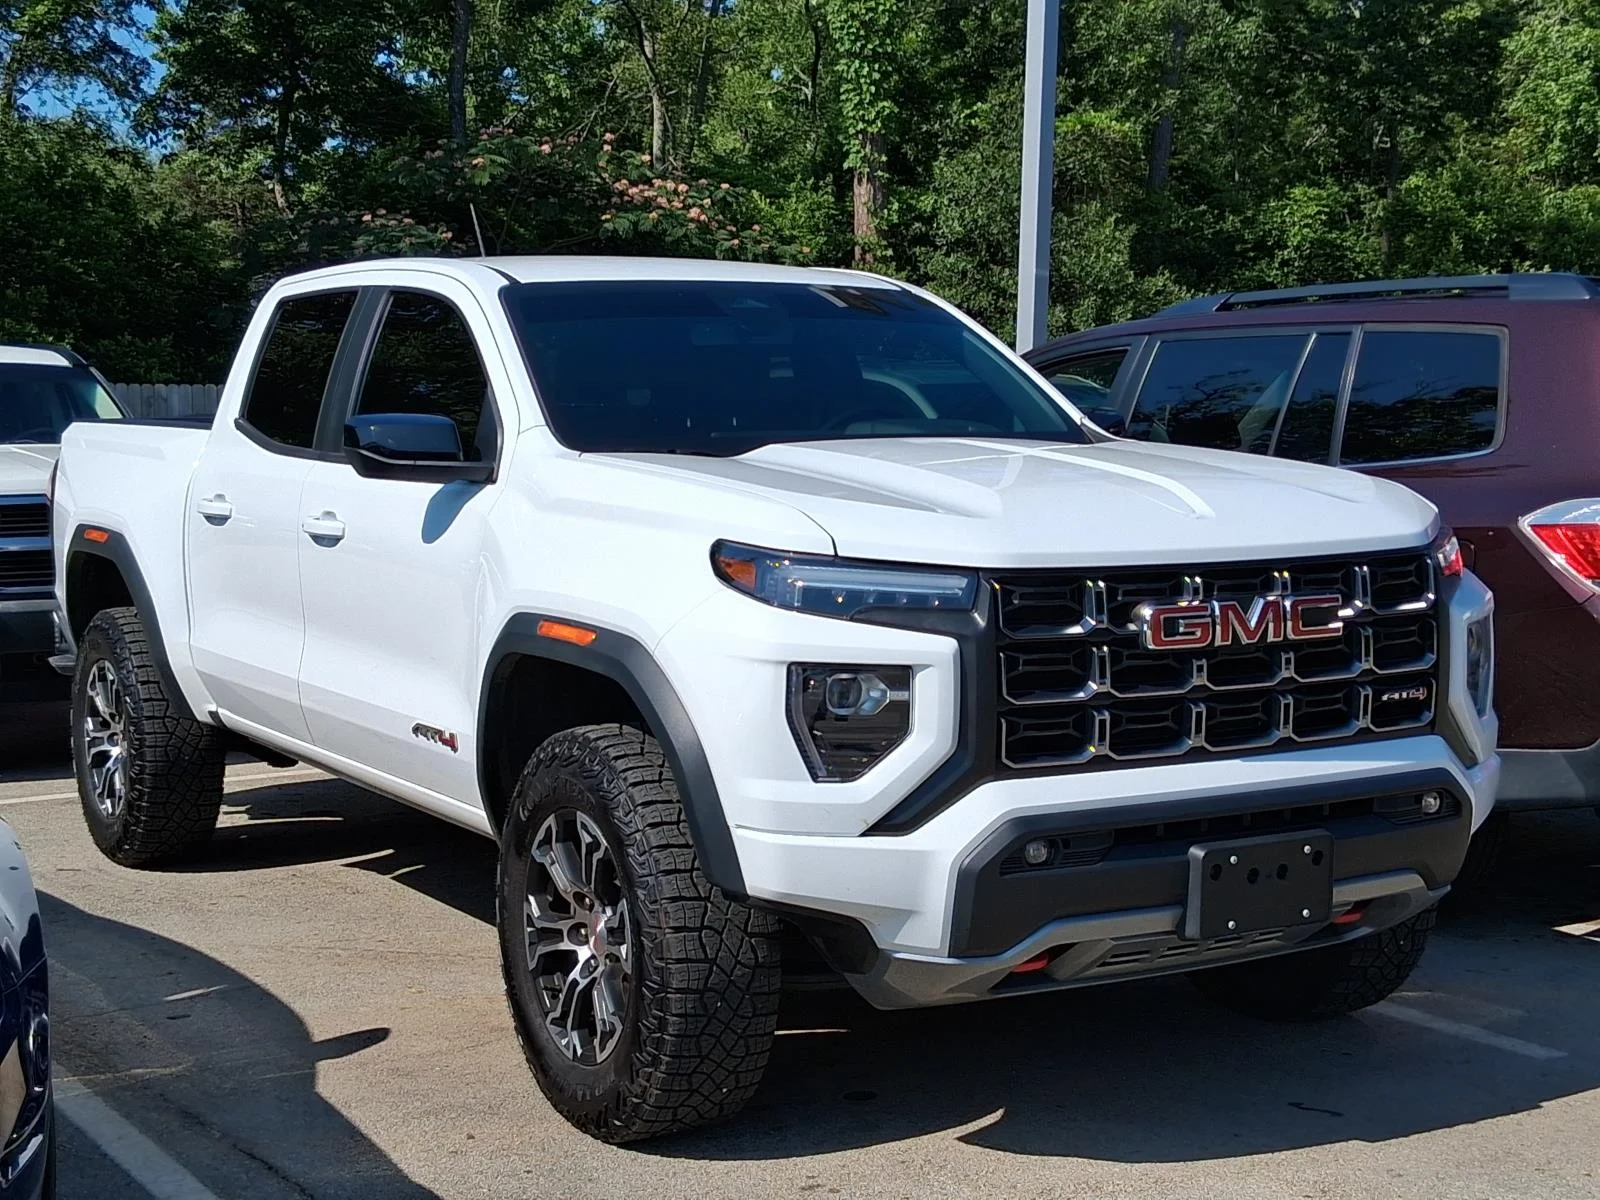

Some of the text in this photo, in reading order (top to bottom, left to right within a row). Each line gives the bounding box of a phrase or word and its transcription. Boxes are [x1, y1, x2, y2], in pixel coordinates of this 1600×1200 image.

[1145, 594, 1343, 650] GMC
[1381, 687, 1427, 701] AT4
[411, 722, 459, 754] AT4
